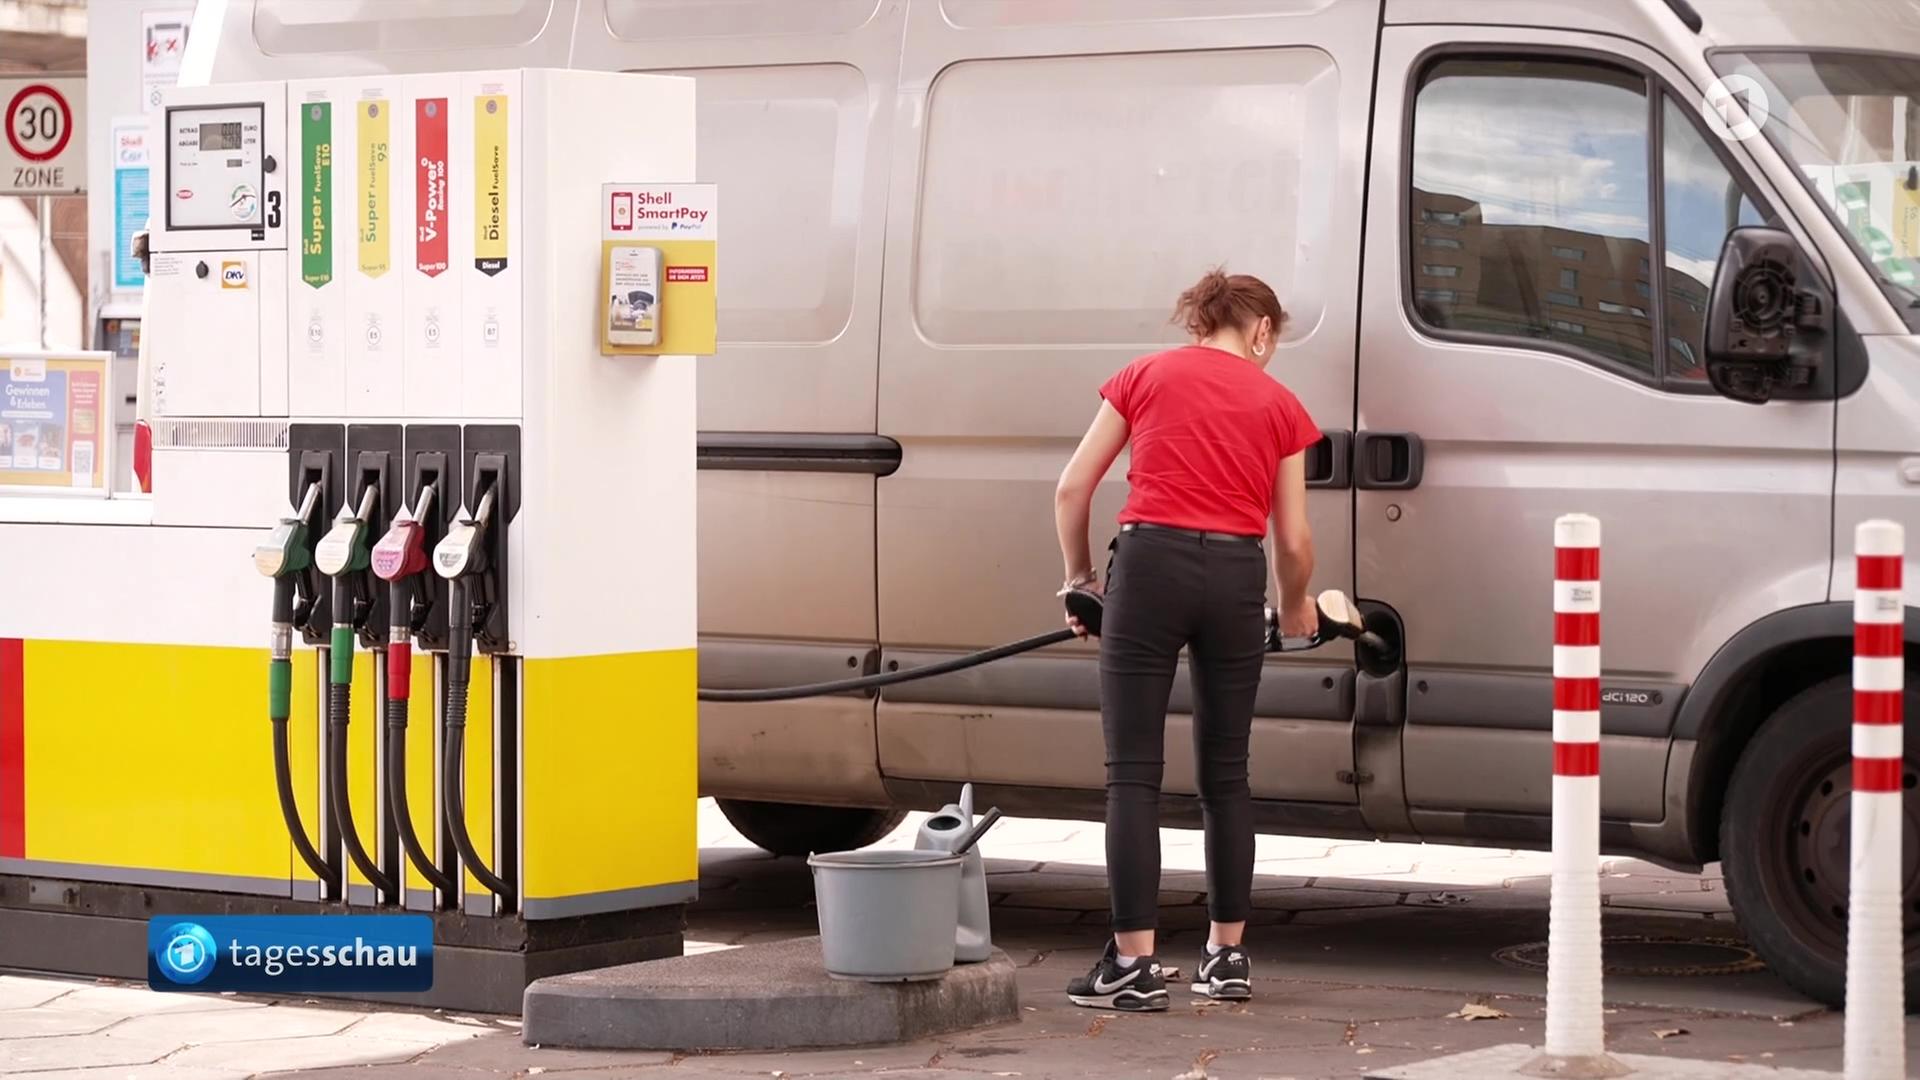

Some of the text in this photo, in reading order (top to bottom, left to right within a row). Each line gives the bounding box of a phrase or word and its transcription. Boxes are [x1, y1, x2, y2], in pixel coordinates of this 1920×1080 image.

[20, 106, 57, 140] 30
[321, 143, 330, 166] E10
[377, 143, 387, 162] 95
[14, 167, 64, 187] ZONE
[425, 160, 437, 242] V-Power
[437, 180, 445, 211] Racing
[638, 192, 671, 204] Shell
[268, 191, 281, 228] 3
[366, 192, 379, 242] Super
[488, 192, 499, 240] Diesel
[638, 207, 708, 222] SmartPay
[310, 196, 325, 254] Super
[419, 262, 446, 271] Super 100
[482, 261, 500, 269] Diesel
[225, 270, 245, 280] DKV
[5, 384, 50, 396] Gewinnen
[17, 398, 47, 409] Erleben
[1602, 692, 1648, 703] dCi 120
